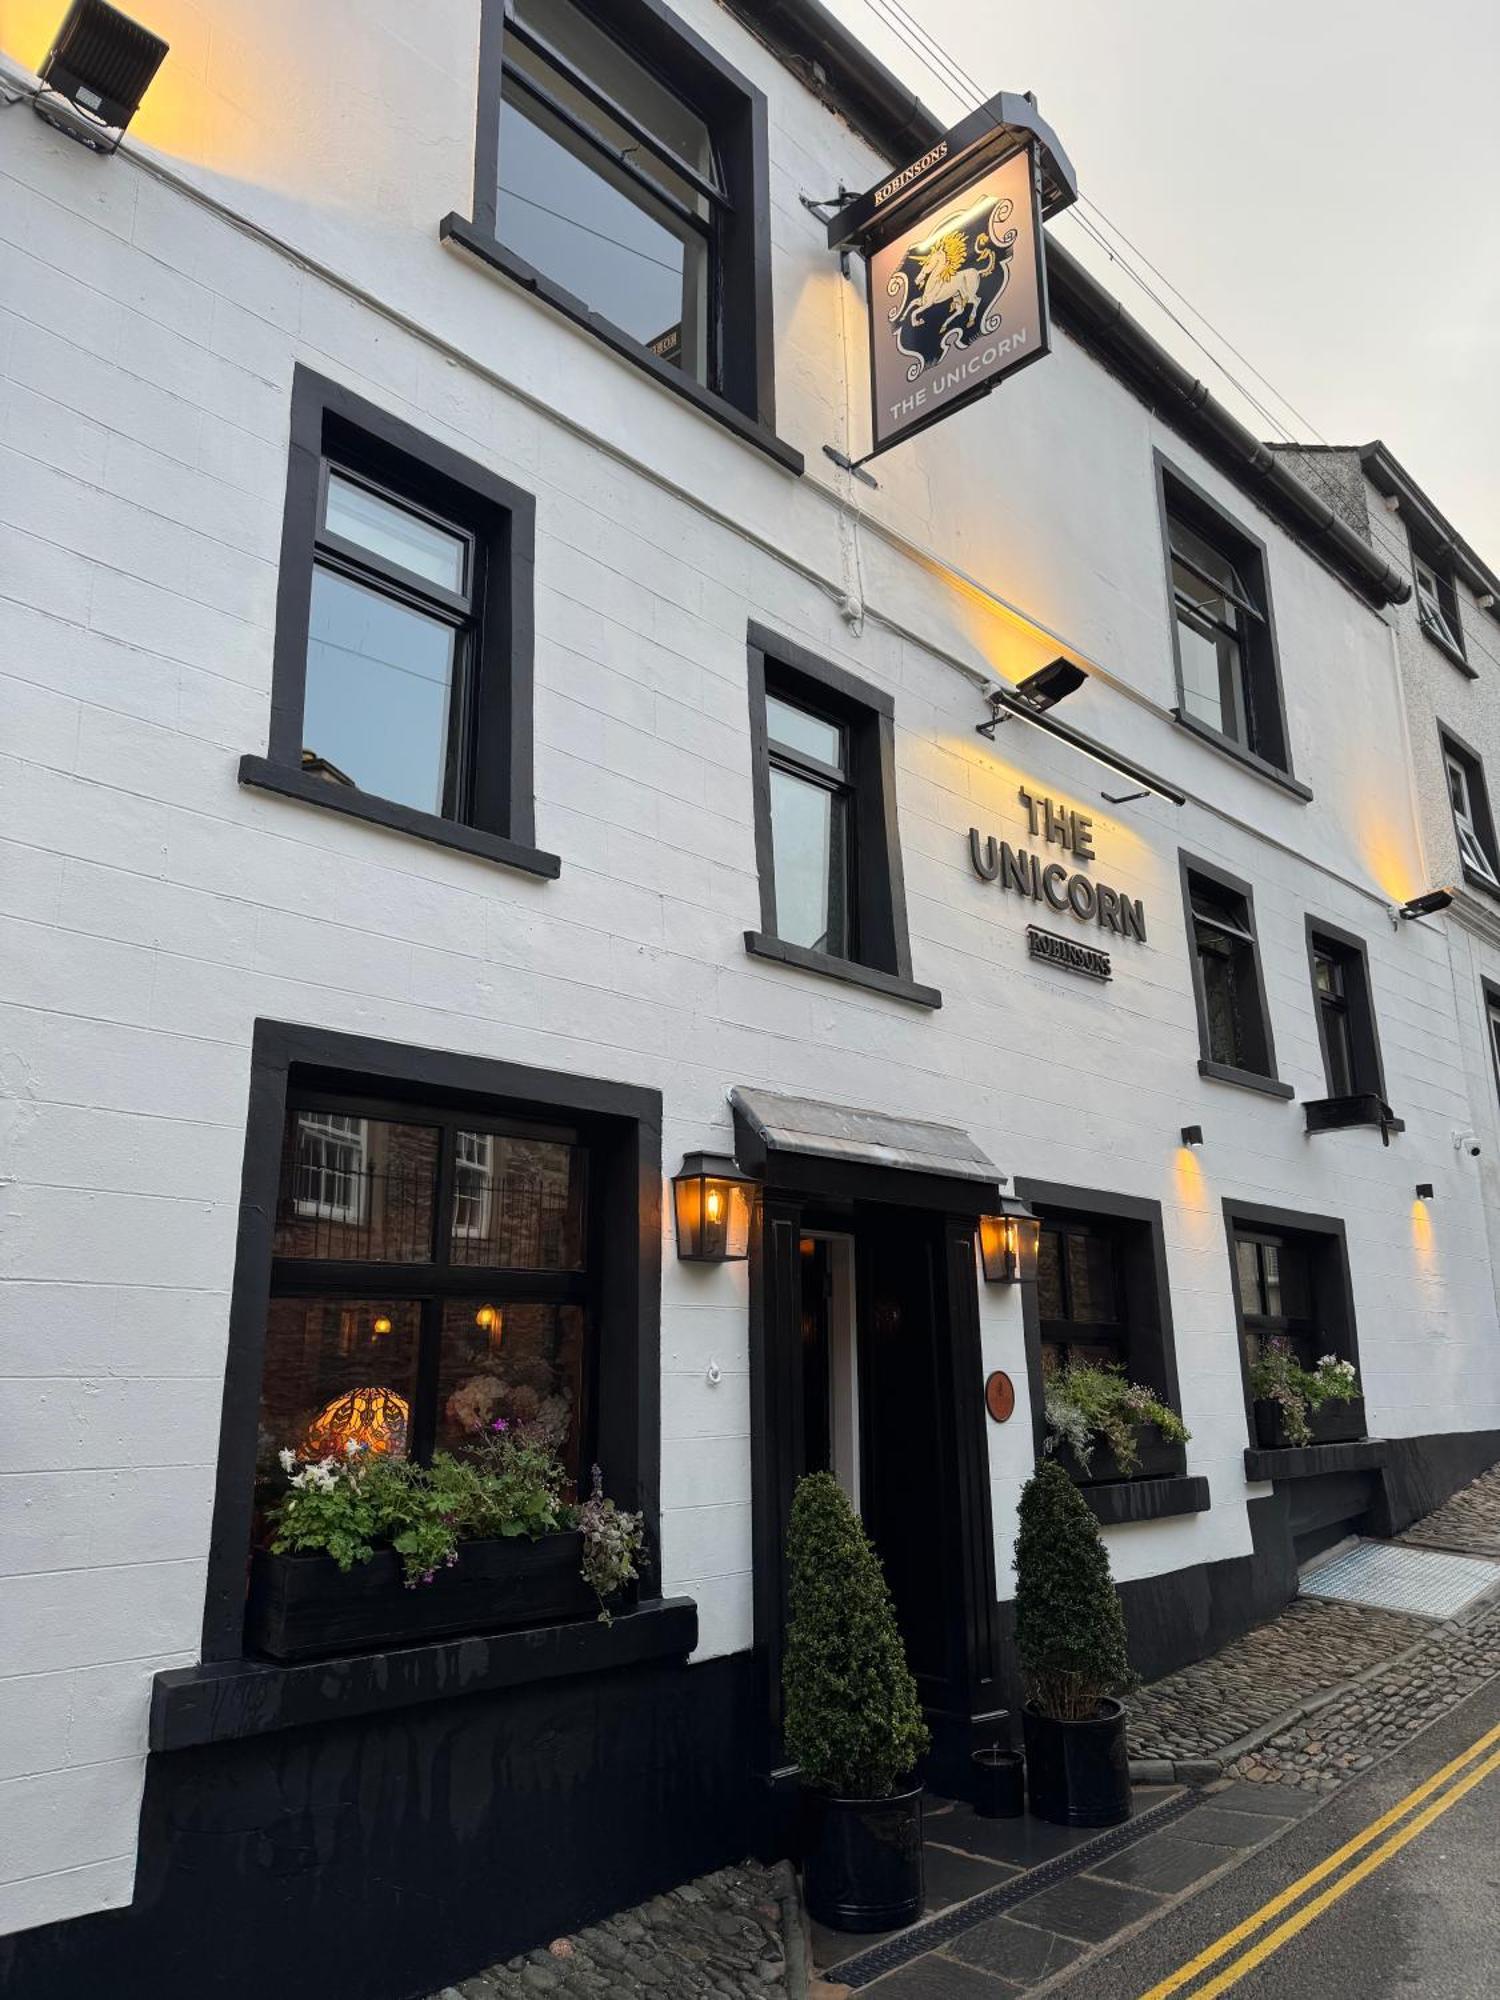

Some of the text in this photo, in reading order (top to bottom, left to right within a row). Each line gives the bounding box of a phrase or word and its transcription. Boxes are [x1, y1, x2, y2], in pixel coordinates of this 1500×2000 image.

[874, 141, 948, 206] ROBINSONS
[890, 329, 1028, 420] THE UNICORN
[1019, 785, 1096, 860] THE
[969, 827, 1147, 942] UNICORN
[1028, 930, 1112, 976] ROBINSONS
